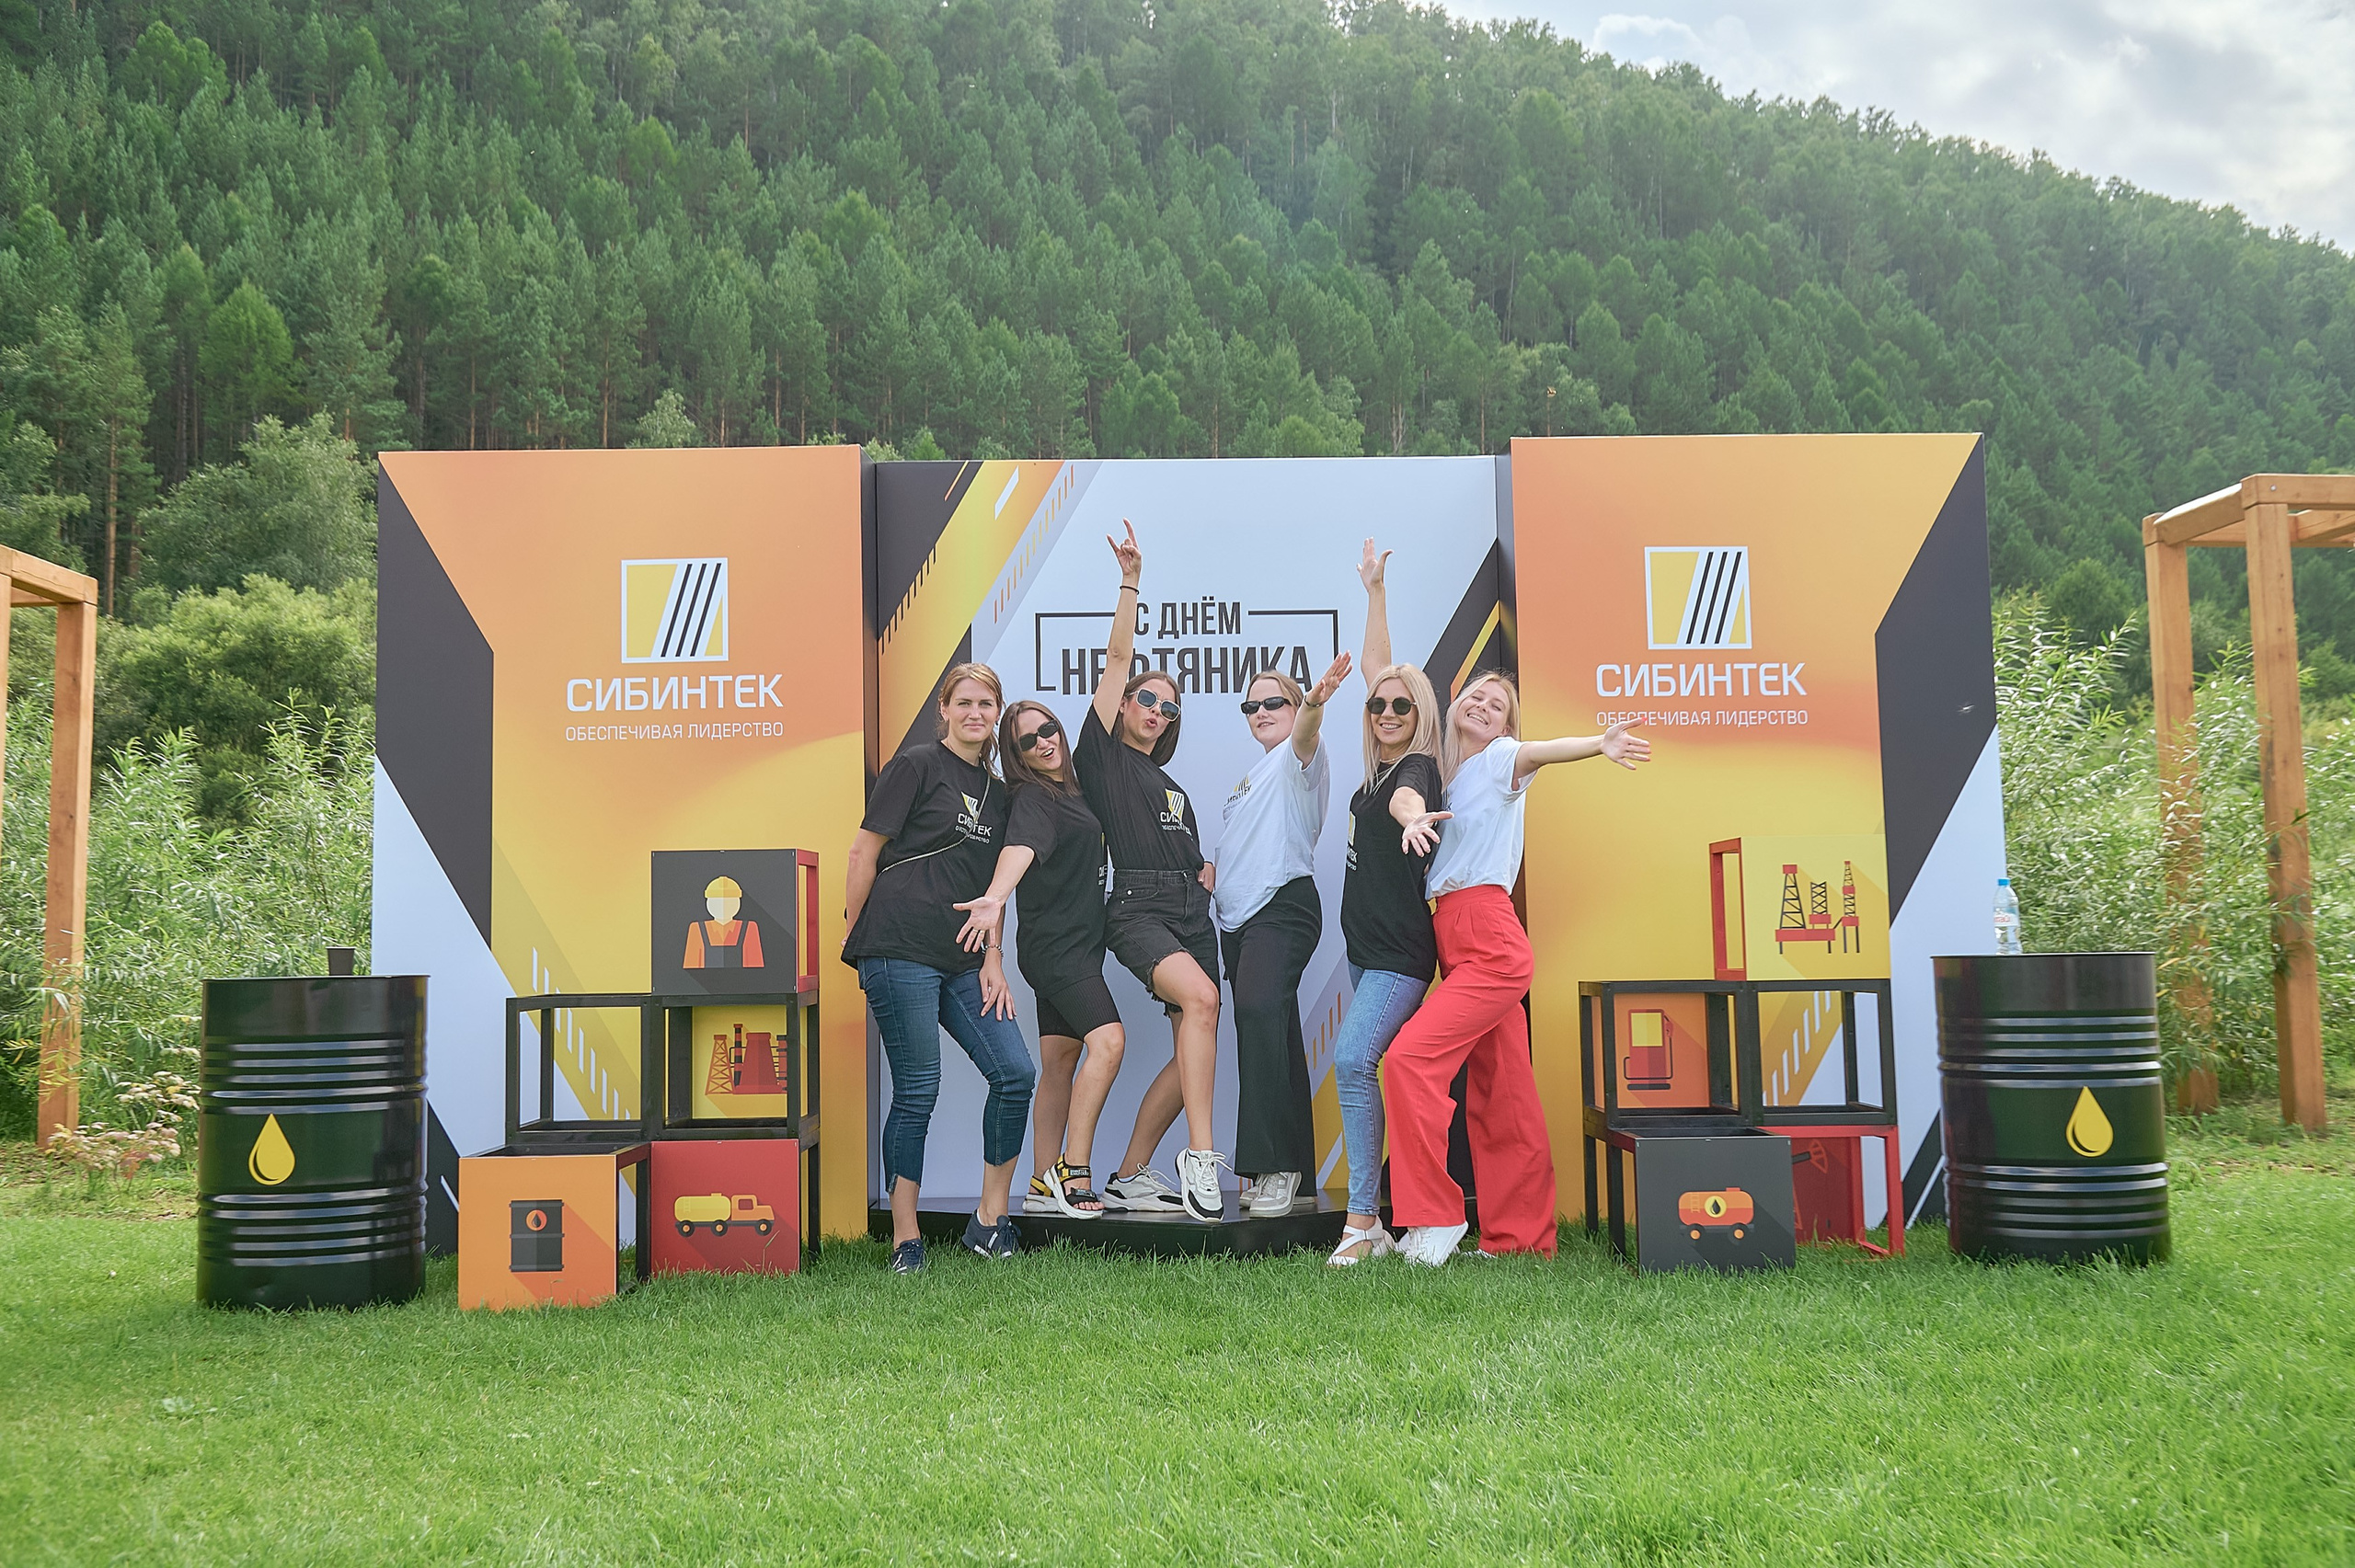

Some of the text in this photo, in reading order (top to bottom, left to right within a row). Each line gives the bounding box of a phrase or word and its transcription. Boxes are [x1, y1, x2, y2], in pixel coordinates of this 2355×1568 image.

[1134, 596, 1242, 640] С ДНЁМ
[567, 674, 784, 712] СИБИНТЕК
[1596, 662, 1808, 697] СИБИНТЕК
[566, 722, 784, 741] ОБЕСПЕЧИВАЯ ЛИДЕРСТВО
[1715, 709, 1809, 728] ЛИДЕРСТВО
